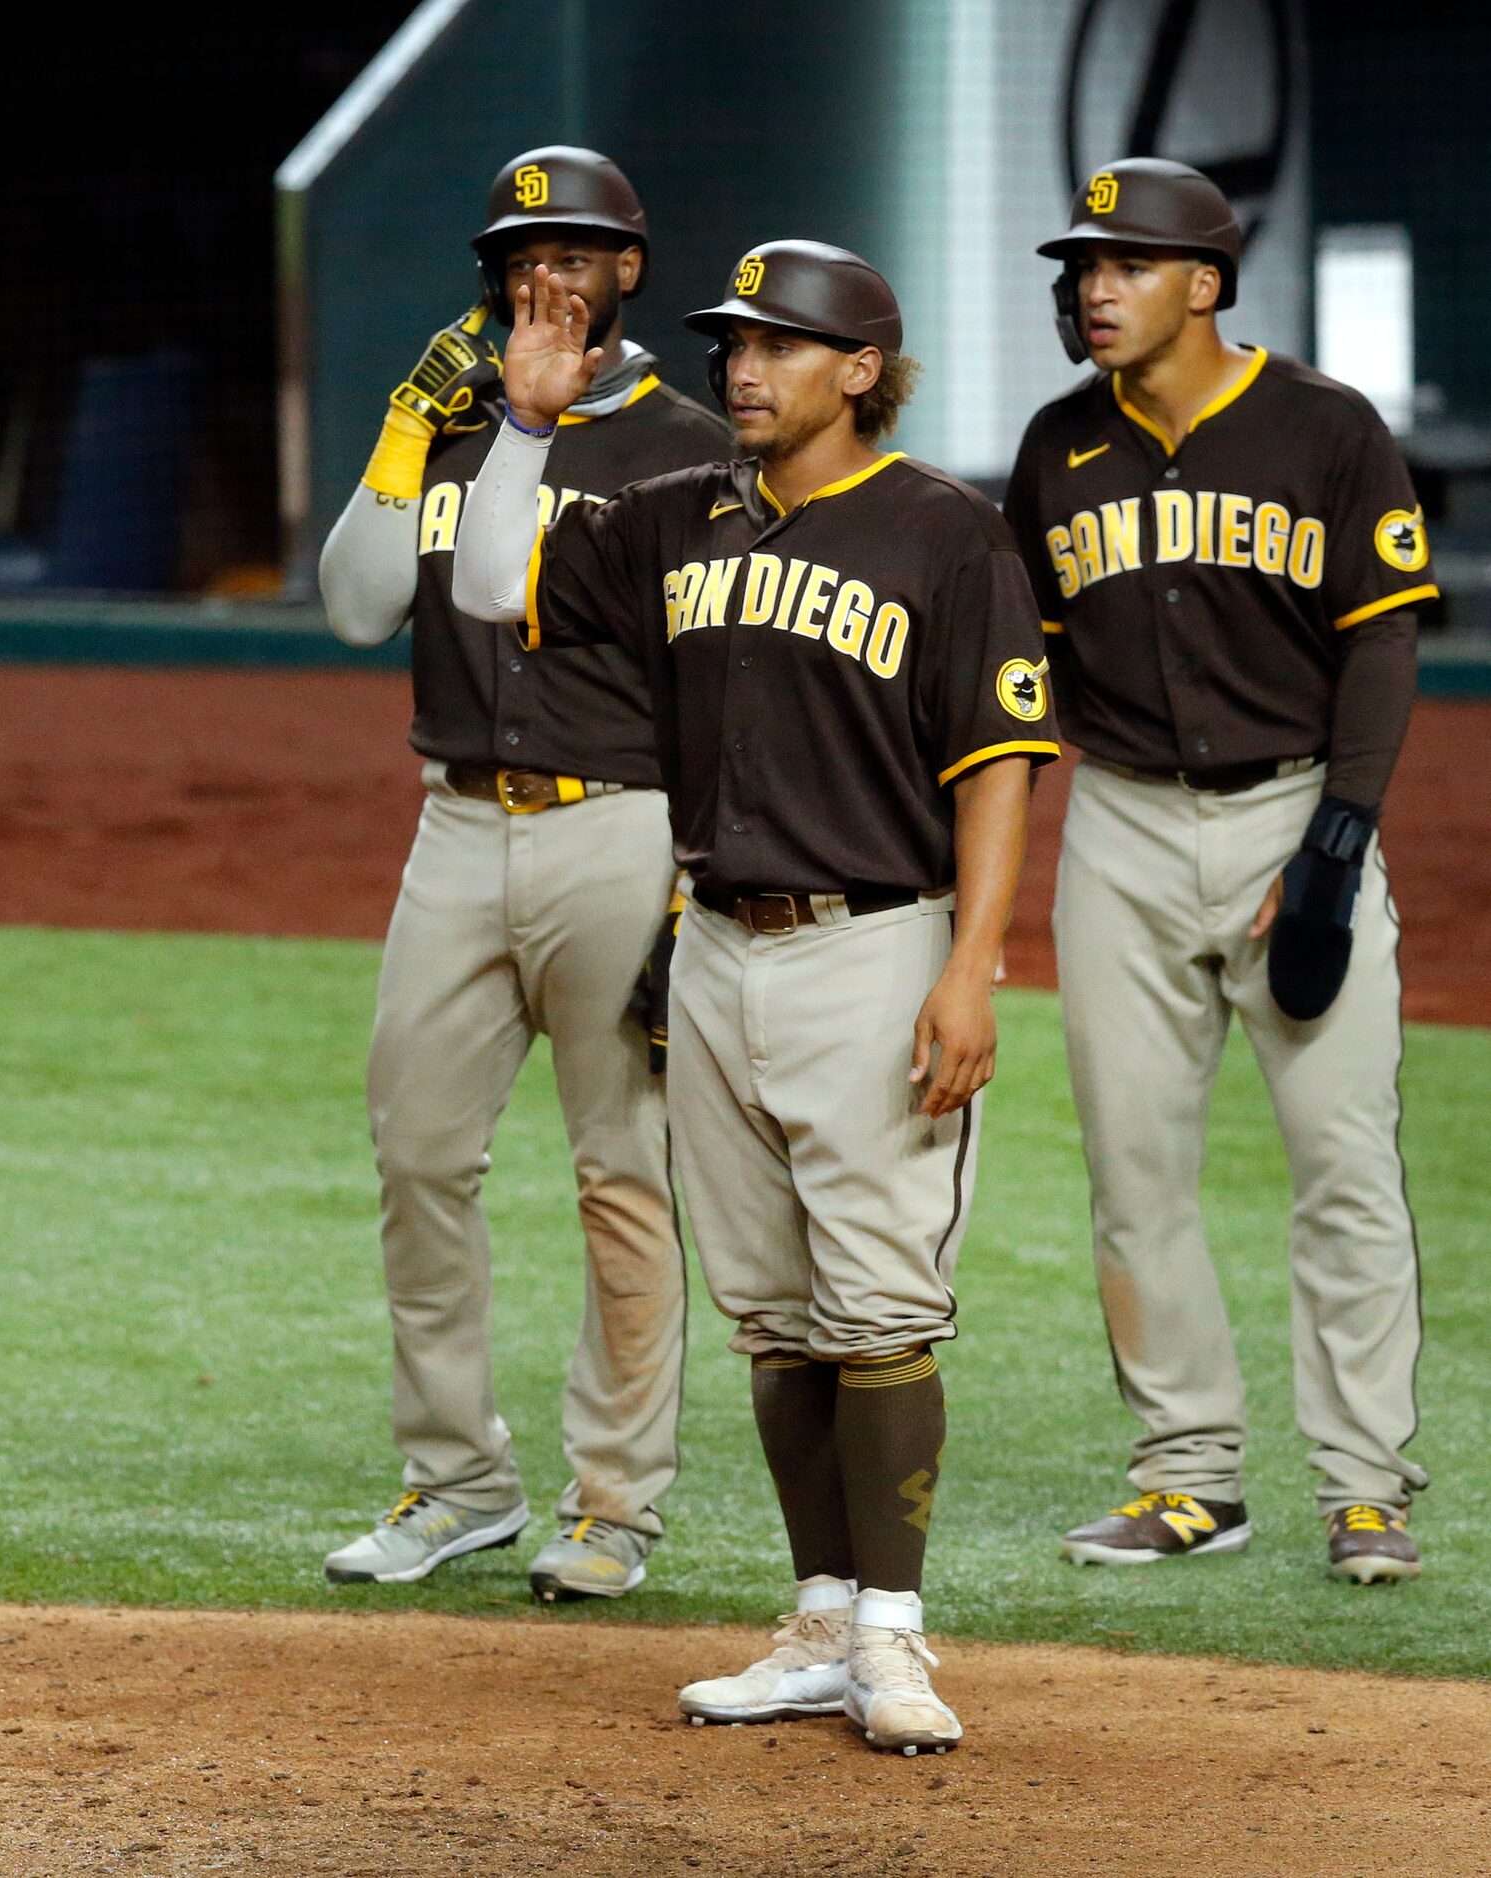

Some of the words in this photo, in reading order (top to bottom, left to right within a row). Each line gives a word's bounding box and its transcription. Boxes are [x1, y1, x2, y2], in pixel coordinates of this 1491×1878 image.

[1045, 496, 1144, 600] SAN
[1152, 489, 1326, 590] DIEGO
[663, 556, 743, 645] SAN
[738, 552, 910, 680] DIEGO
